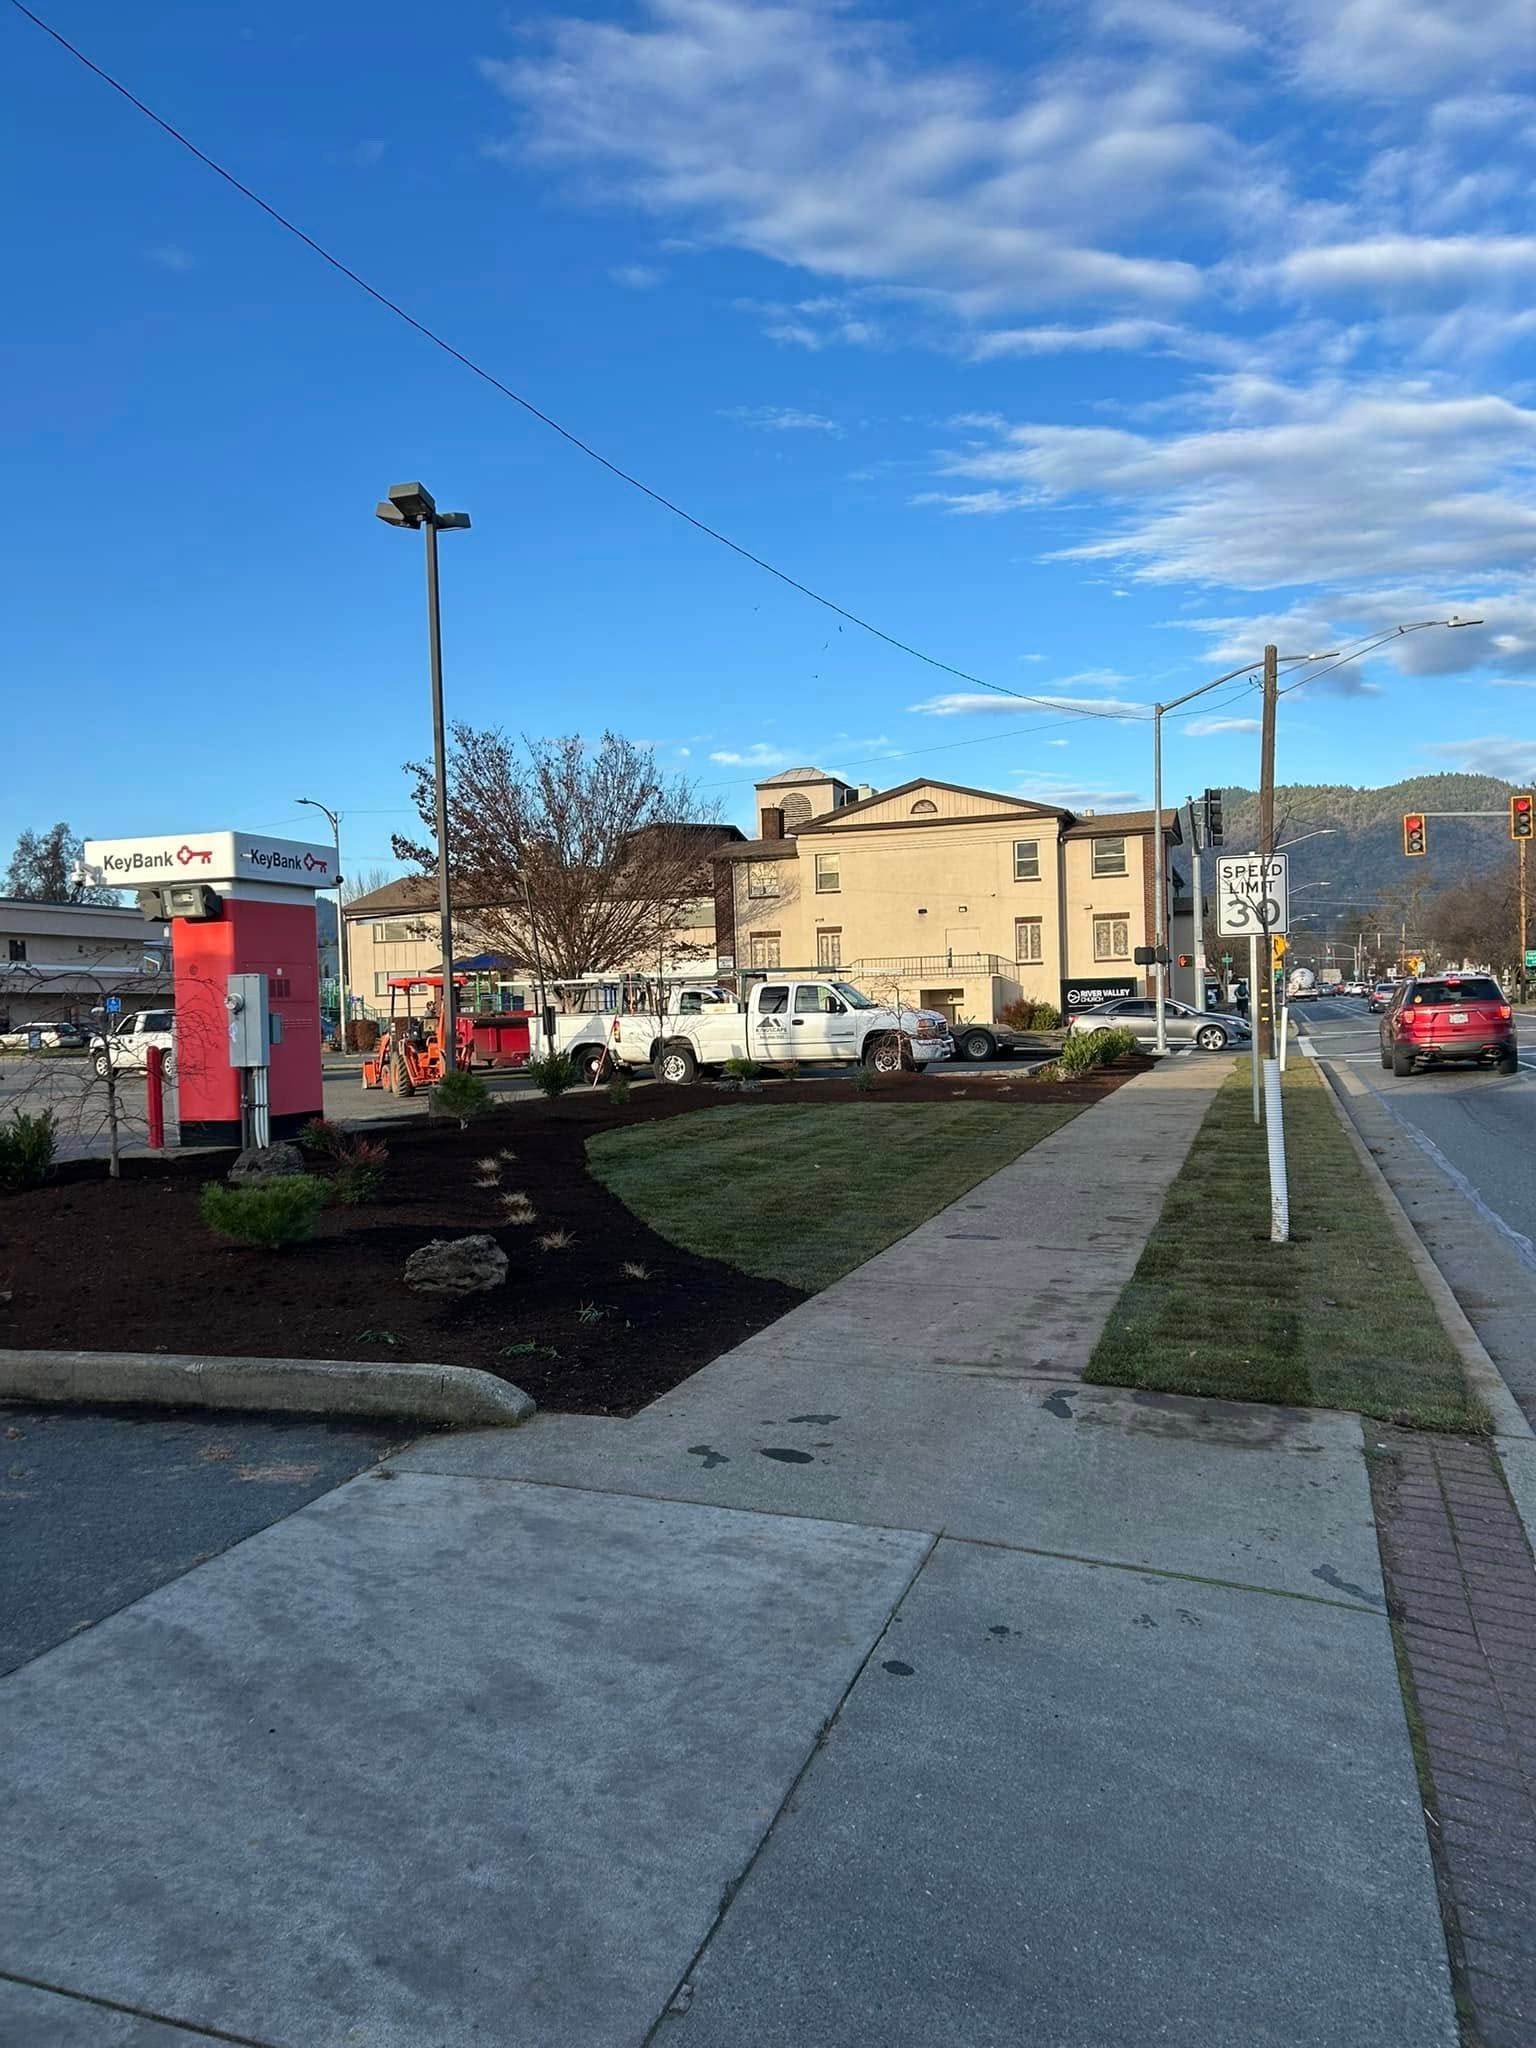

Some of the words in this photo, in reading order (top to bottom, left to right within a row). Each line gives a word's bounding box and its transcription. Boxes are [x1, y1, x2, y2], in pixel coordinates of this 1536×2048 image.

[103, 851, 173, 872] KeyBank
[251, 849, 302, 870] KeyBank
[1223, 864, 1282, 878] SPEED
[1229, 880, 1275, 894] LIMIT
[1226, 898, 1280, 927] 30
[1103, 988, 1130, 996] VALLEY
